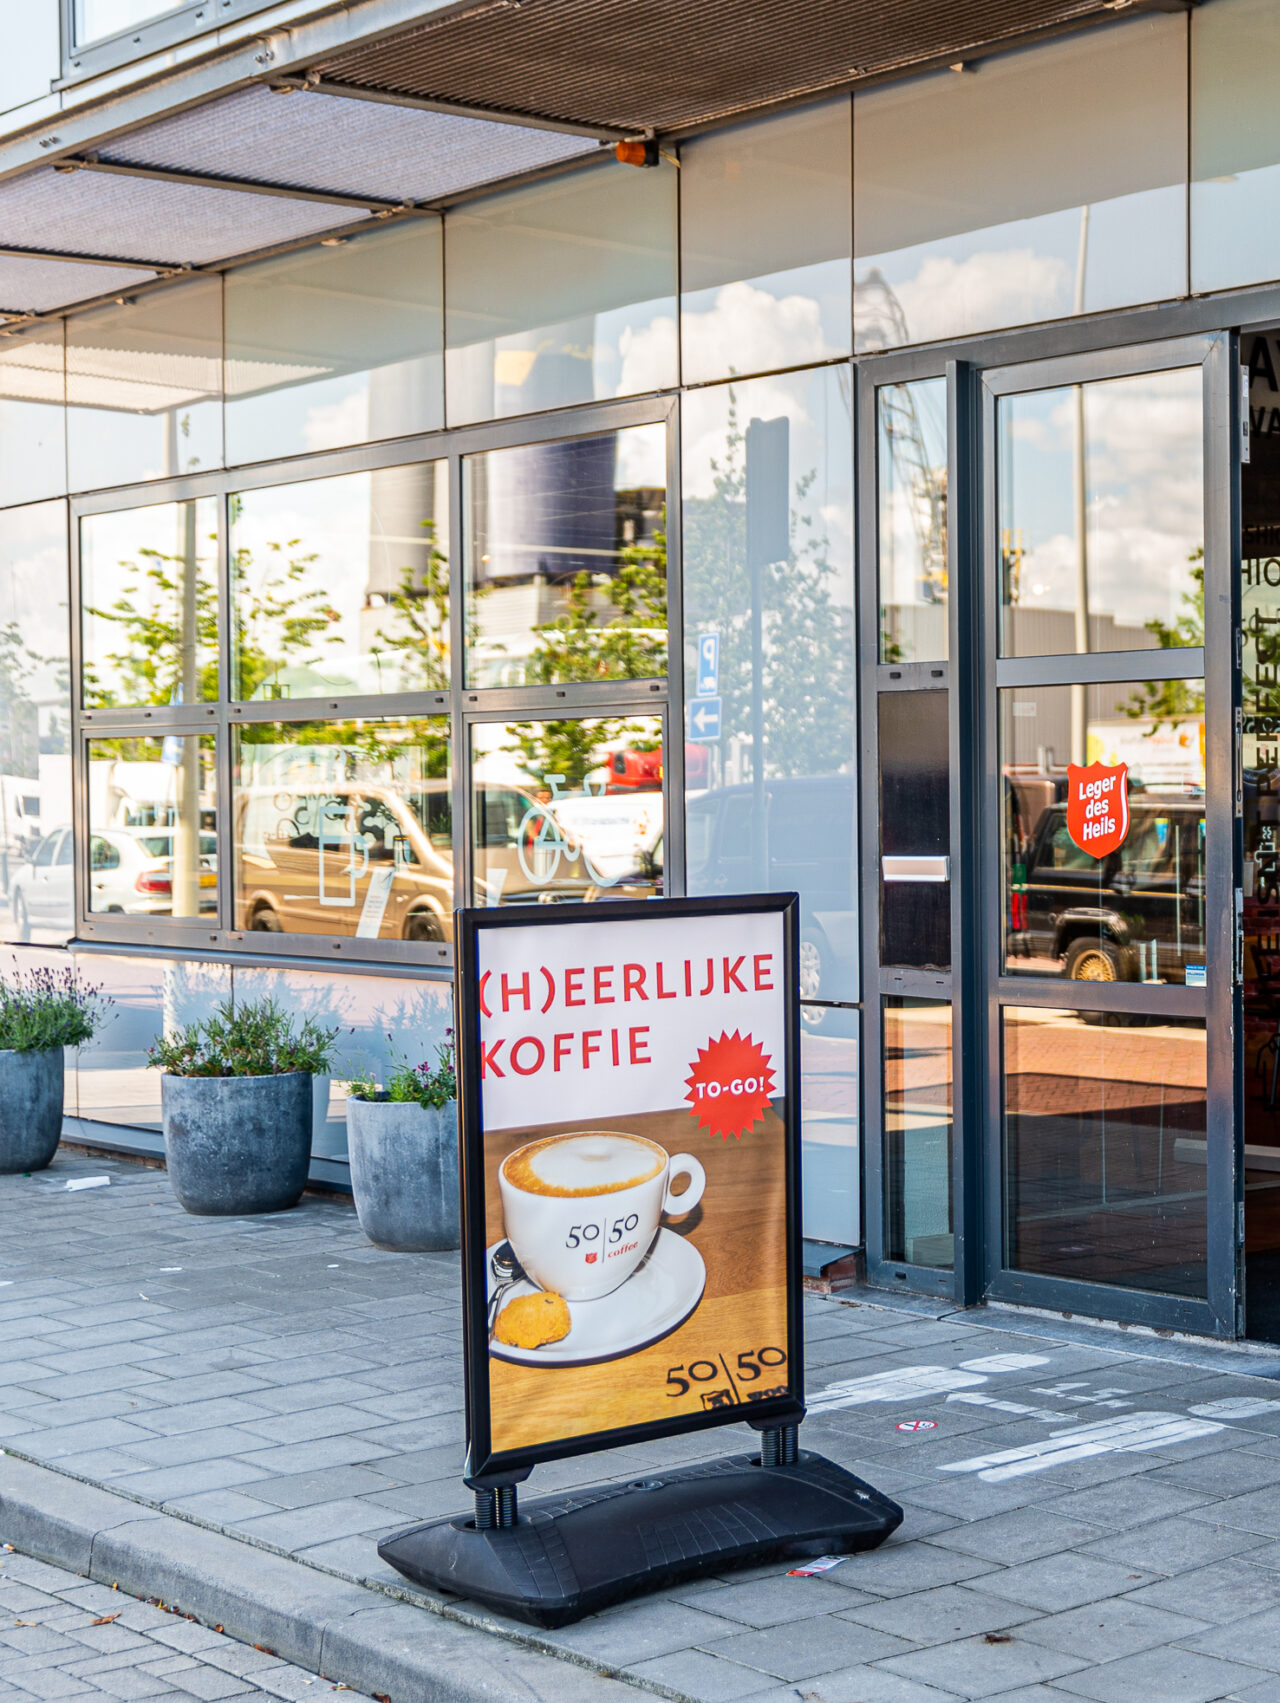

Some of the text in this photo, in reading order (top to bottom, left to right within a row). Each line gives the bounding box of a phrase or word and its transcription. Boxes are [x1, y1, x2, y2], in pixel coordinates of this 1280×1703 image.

[1255, 607, 1278, 796] PERFECT
[1078, 775, 1116, 801] Leger
[1085, 799, 1109, 819] des
[1082, 815, 1116, 841] Heils
[479, 953, 774, 1019] (H)EERLIJKE
[480, 1026, 652, 1080] KOFFIE
[696, 1076, 765, 1100] TO-GO!
[607, 1241, 639, 1258] coffee
